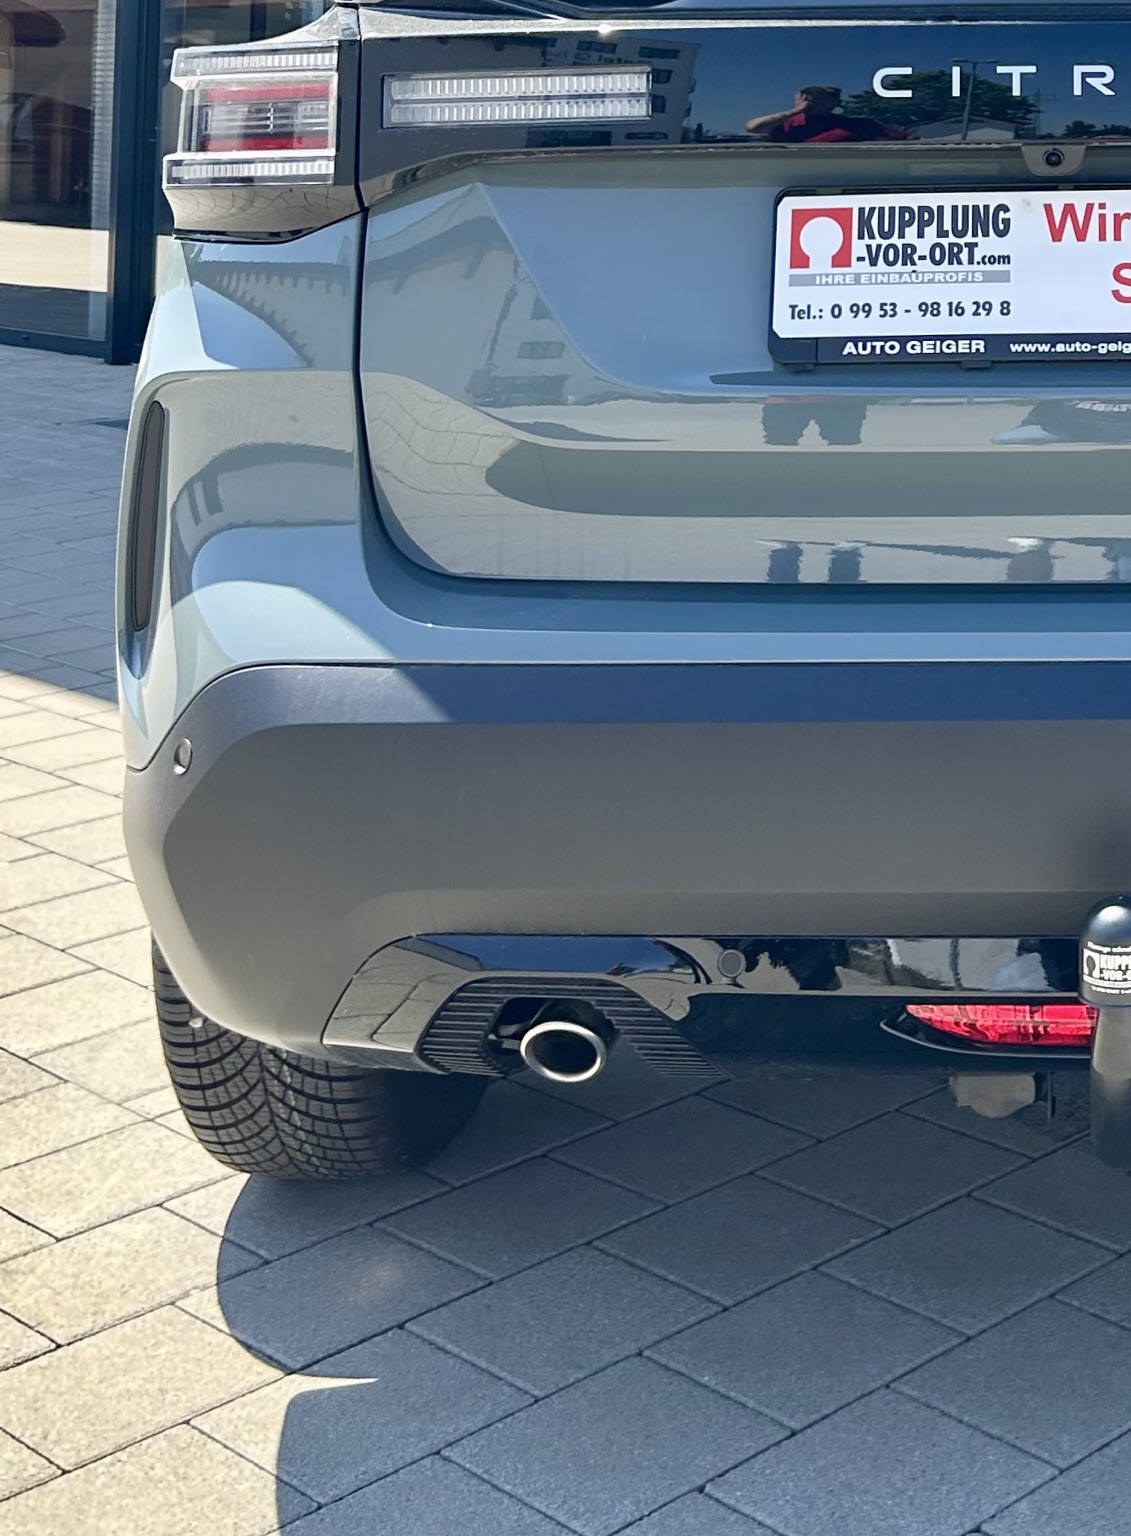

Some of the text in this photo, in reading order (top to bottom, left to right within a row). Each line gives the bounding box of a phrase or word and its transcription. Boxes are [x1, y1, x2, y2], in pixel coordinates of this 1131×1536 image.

[856, 203, 1011, 240] KUPPLUNG
[1042, 202, 1131, 244] Wir
[815, 271, 984, 286] IHRE EINBAUPROFIS
[788, 304, 824, 320] Tel.:
[830, 303, 843, 320] 0
[849, 302, 873, 319] 99
[878, 301, 898, 319] 53
[918, 301, 941, 318] 98
[947, 301, 966, 318] 16
[971, 300, 993, 317] 29
[999, 300, 1011, 317] 8
[842, 340, 901, 355] AUTO
[905, 339, 986, 354] GEIGER
